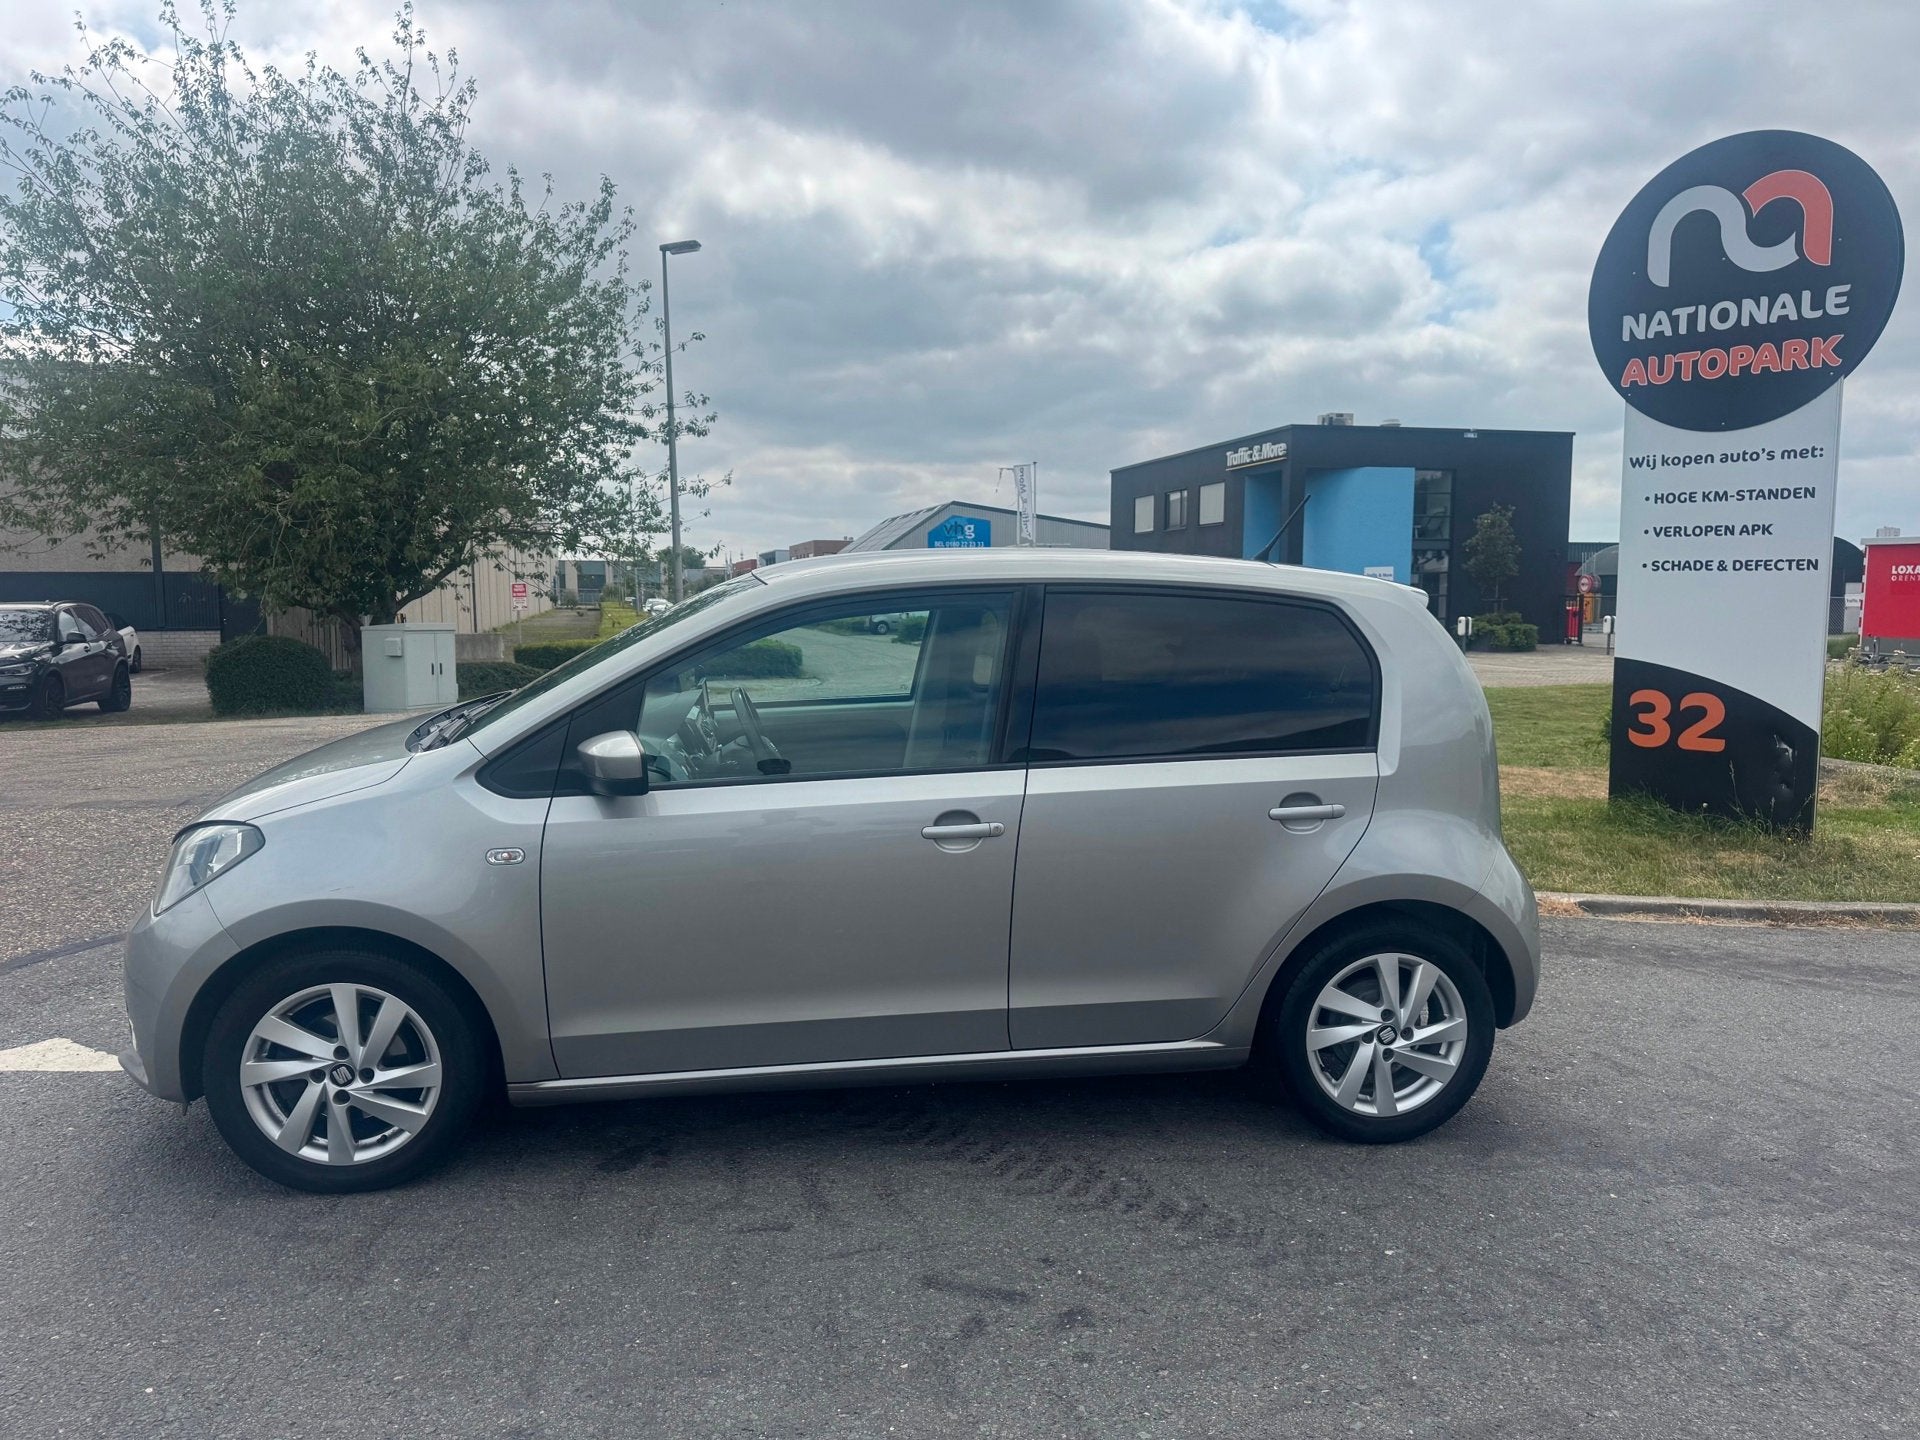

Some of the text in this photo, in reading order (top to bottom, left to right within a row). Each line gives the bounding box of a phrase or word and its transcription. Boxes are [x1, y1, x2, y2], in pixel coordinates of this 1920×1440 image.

[1621, 284, 1851, 341] NATIONALE
[1621, 334, 1844, 387] AUTOPARK
[1226, 442, 1287, 467] Traffic & More
[1629, 445, 1824, 470] Wij kopen auto's met:
[1654, 486, 1816, 504] HOGE KM-STANDEN
[1652, 523, 1774, 538] VERLOPEN APK
[1651, 558, 1819, 572] SCHADE & DEFECTEN
[1628, 689, 1726, 752] 32
